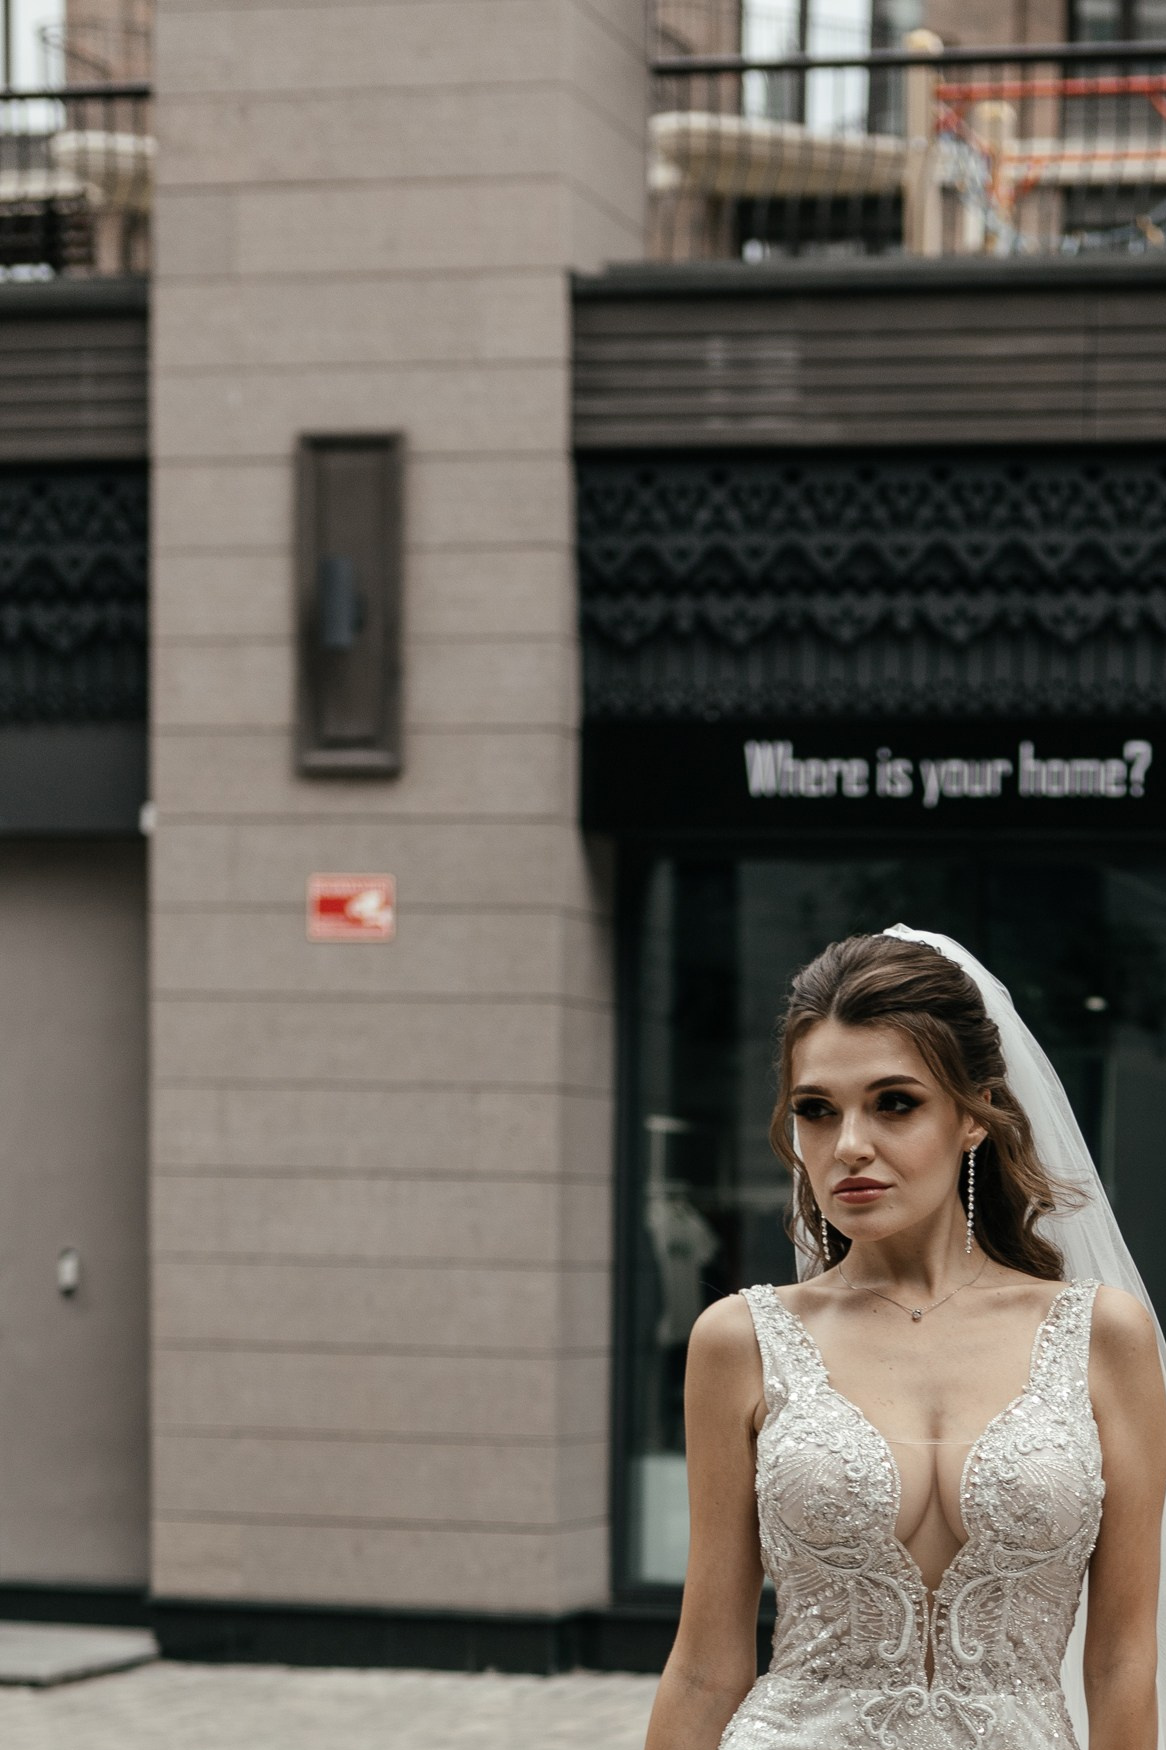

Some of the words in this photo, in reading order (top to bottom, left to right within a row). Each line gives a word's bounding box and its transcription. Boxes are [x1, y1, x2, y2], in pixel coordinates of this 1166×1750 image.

[744, 740, 869, 798] Where
[876, 747, 913, 798] is
[920, 758, 1013, 808] your
[1019, 739, 1153, 798] home?
